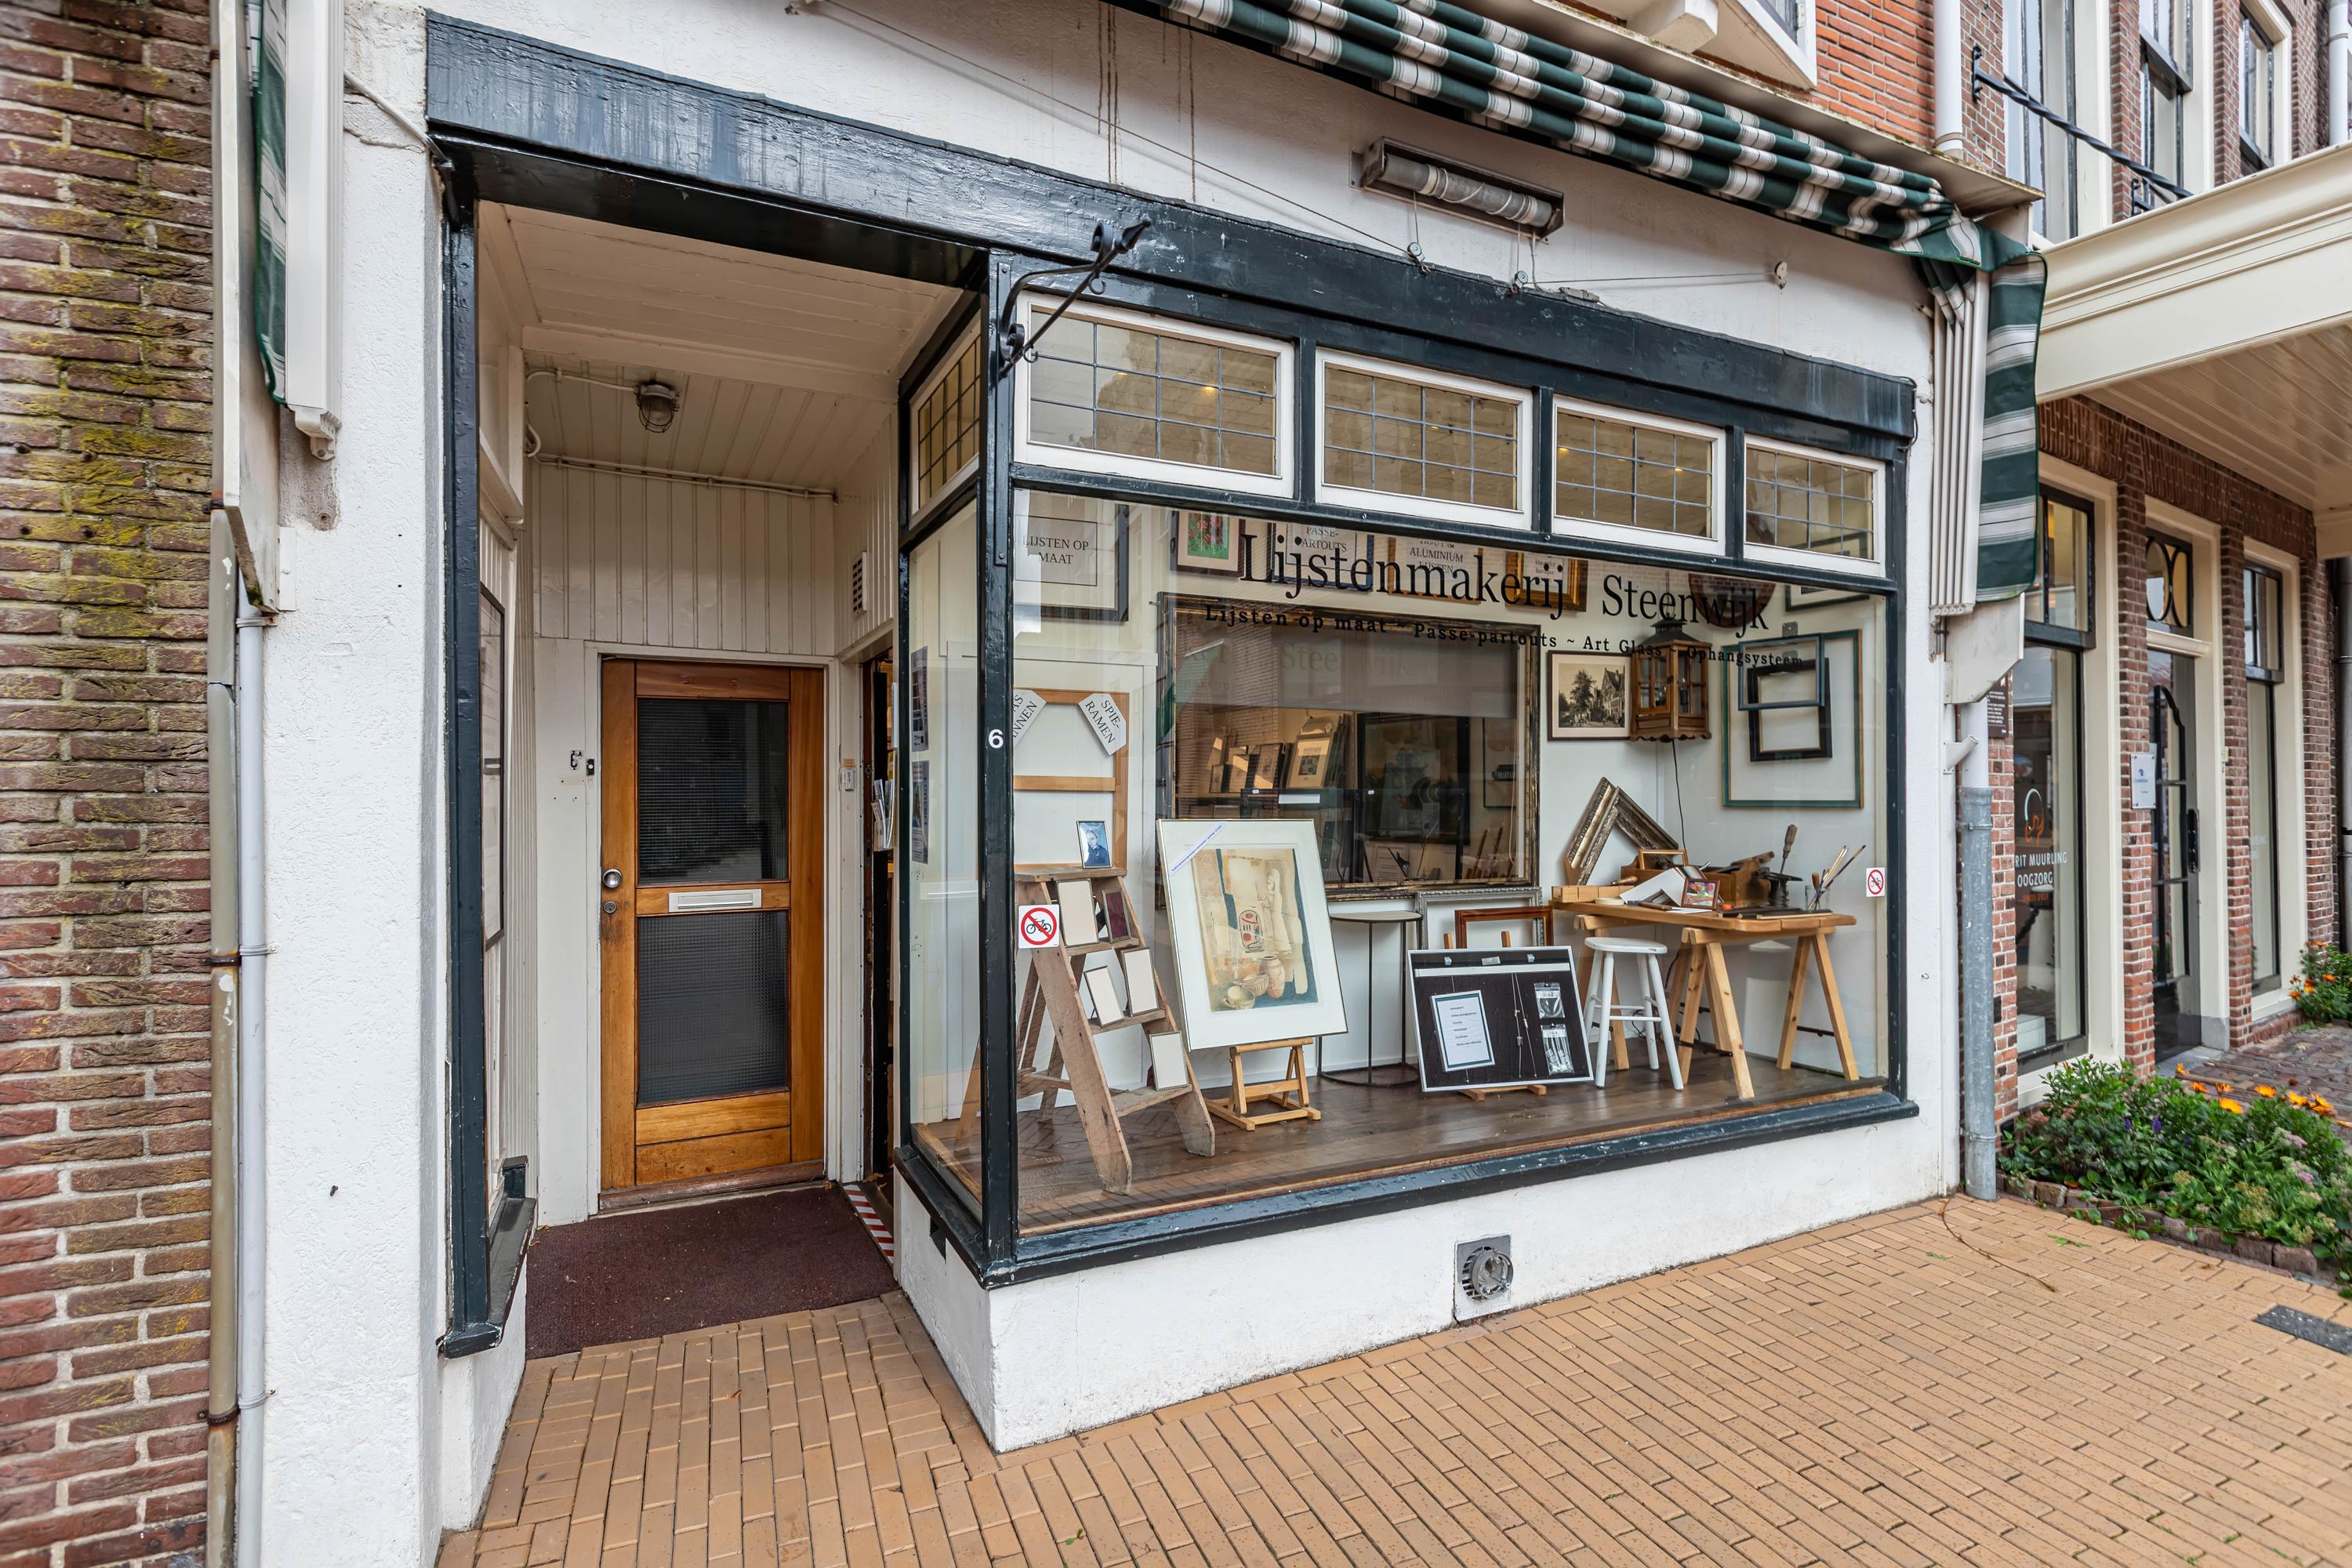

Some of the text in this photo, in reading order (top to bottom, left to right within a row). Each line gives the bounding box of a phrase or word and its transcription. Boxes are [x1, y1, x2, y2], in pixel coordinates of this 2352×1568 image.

[1022, 535, 1089, 551] LIJSTEN OP
[1295, 538, 1347, 552] ARTOUTS
[1038, 552, 1073, 564] MAAT
[1410, 547, 1464, 563] ALUMINIUM
[1240, 533, 1769, 639] Lijstenmakerij Steenwijk
[1205, 604, 1287, 626] Lijsten
[1298, 614, 1323, 633] op
[1334, 617, 1387, 633] maat
[1414, 622, 1557, 648] Passe-partouts
[1583, 636, 1610, 652] Art
[1619, 639, 1662, 656] Glass
[1686, 645, 1802, 672] Ophangsysteem
[1101, 699, 1121, 728] SPIE-
[1085, 700, 1116, 744] RAMEN
[989, 729, 1004, 749] 6
[2029, 851, 2067, 866] MUURLING
[2017, 871, 2053, 887] OOGZORG
